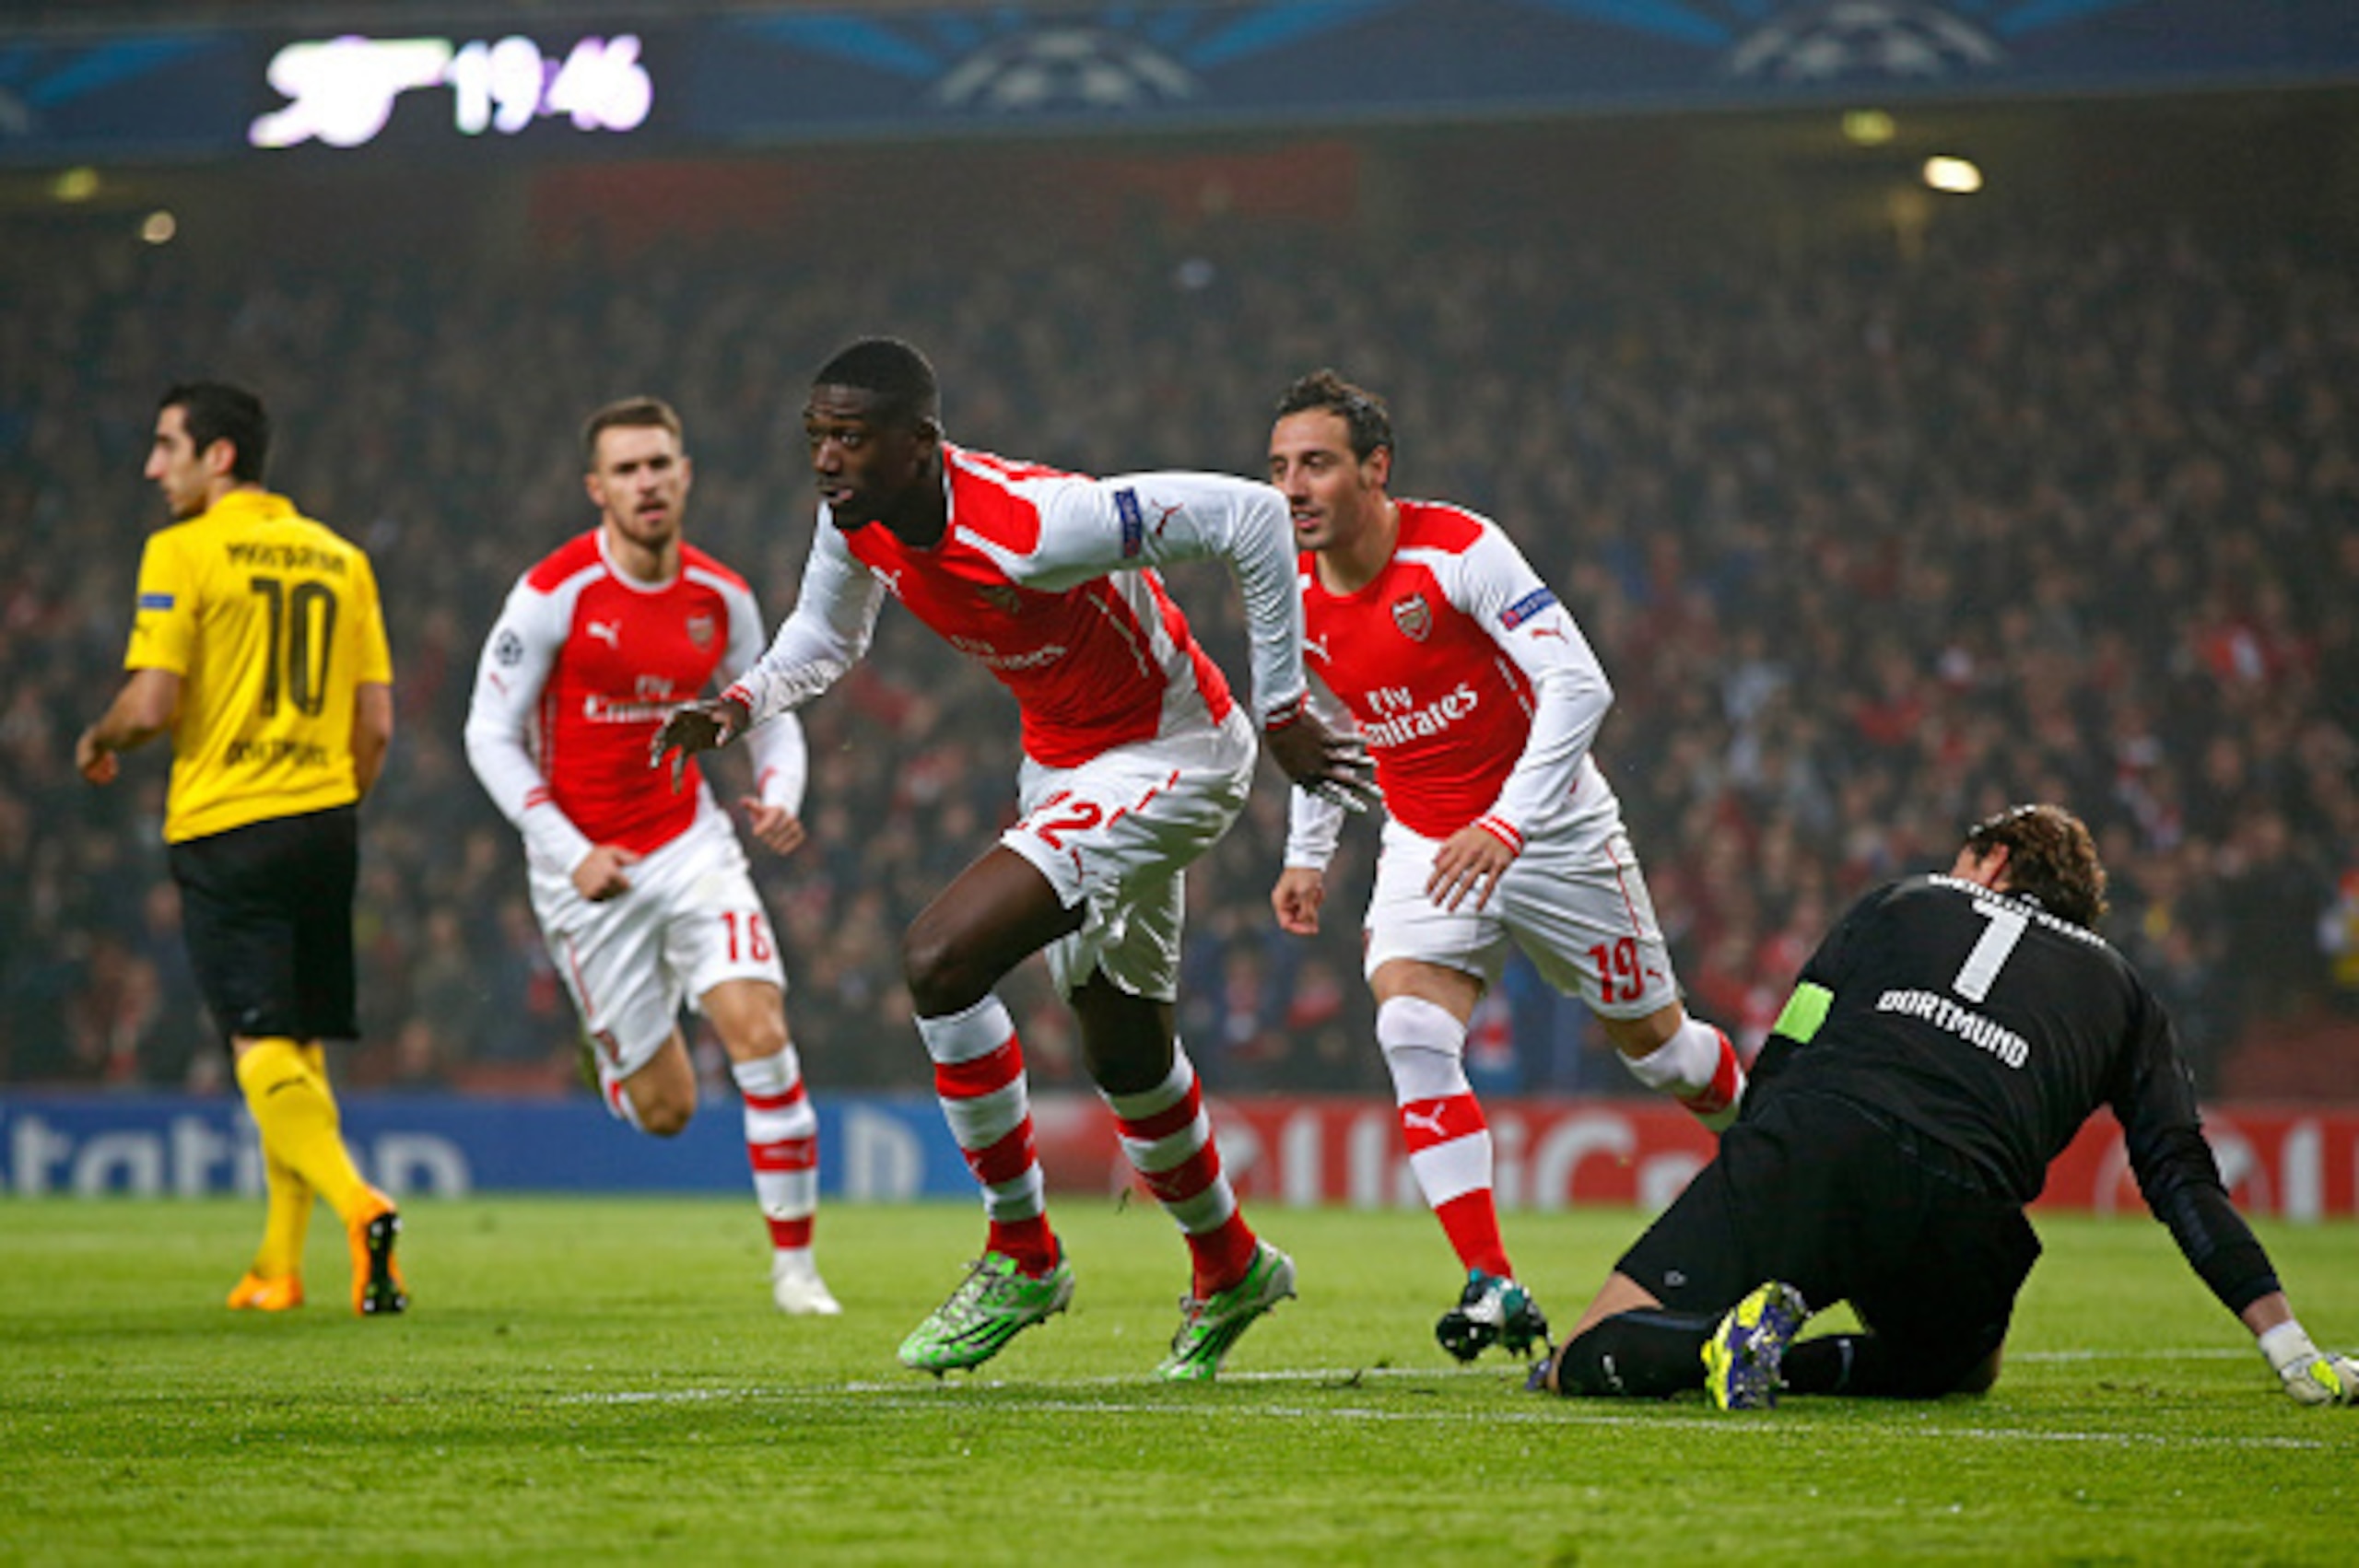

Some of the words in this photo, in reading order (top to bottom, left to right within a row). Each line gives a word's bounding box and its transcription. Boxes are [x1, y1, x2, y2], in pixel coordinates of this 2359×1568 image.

[250, 577, 340, 719] 10
[1364, 680, 1478, 748] mirates
[1365, 685, 1413, 715] Fly
[720, 910, 772, 963] 16
[1587, 936, 1645, 1004] 19
[1952, 897, 2029, 1003] 1
[1875, 989, 2030, 1069] DORTMUND
[11, 1113, 472, 1196] tatin
